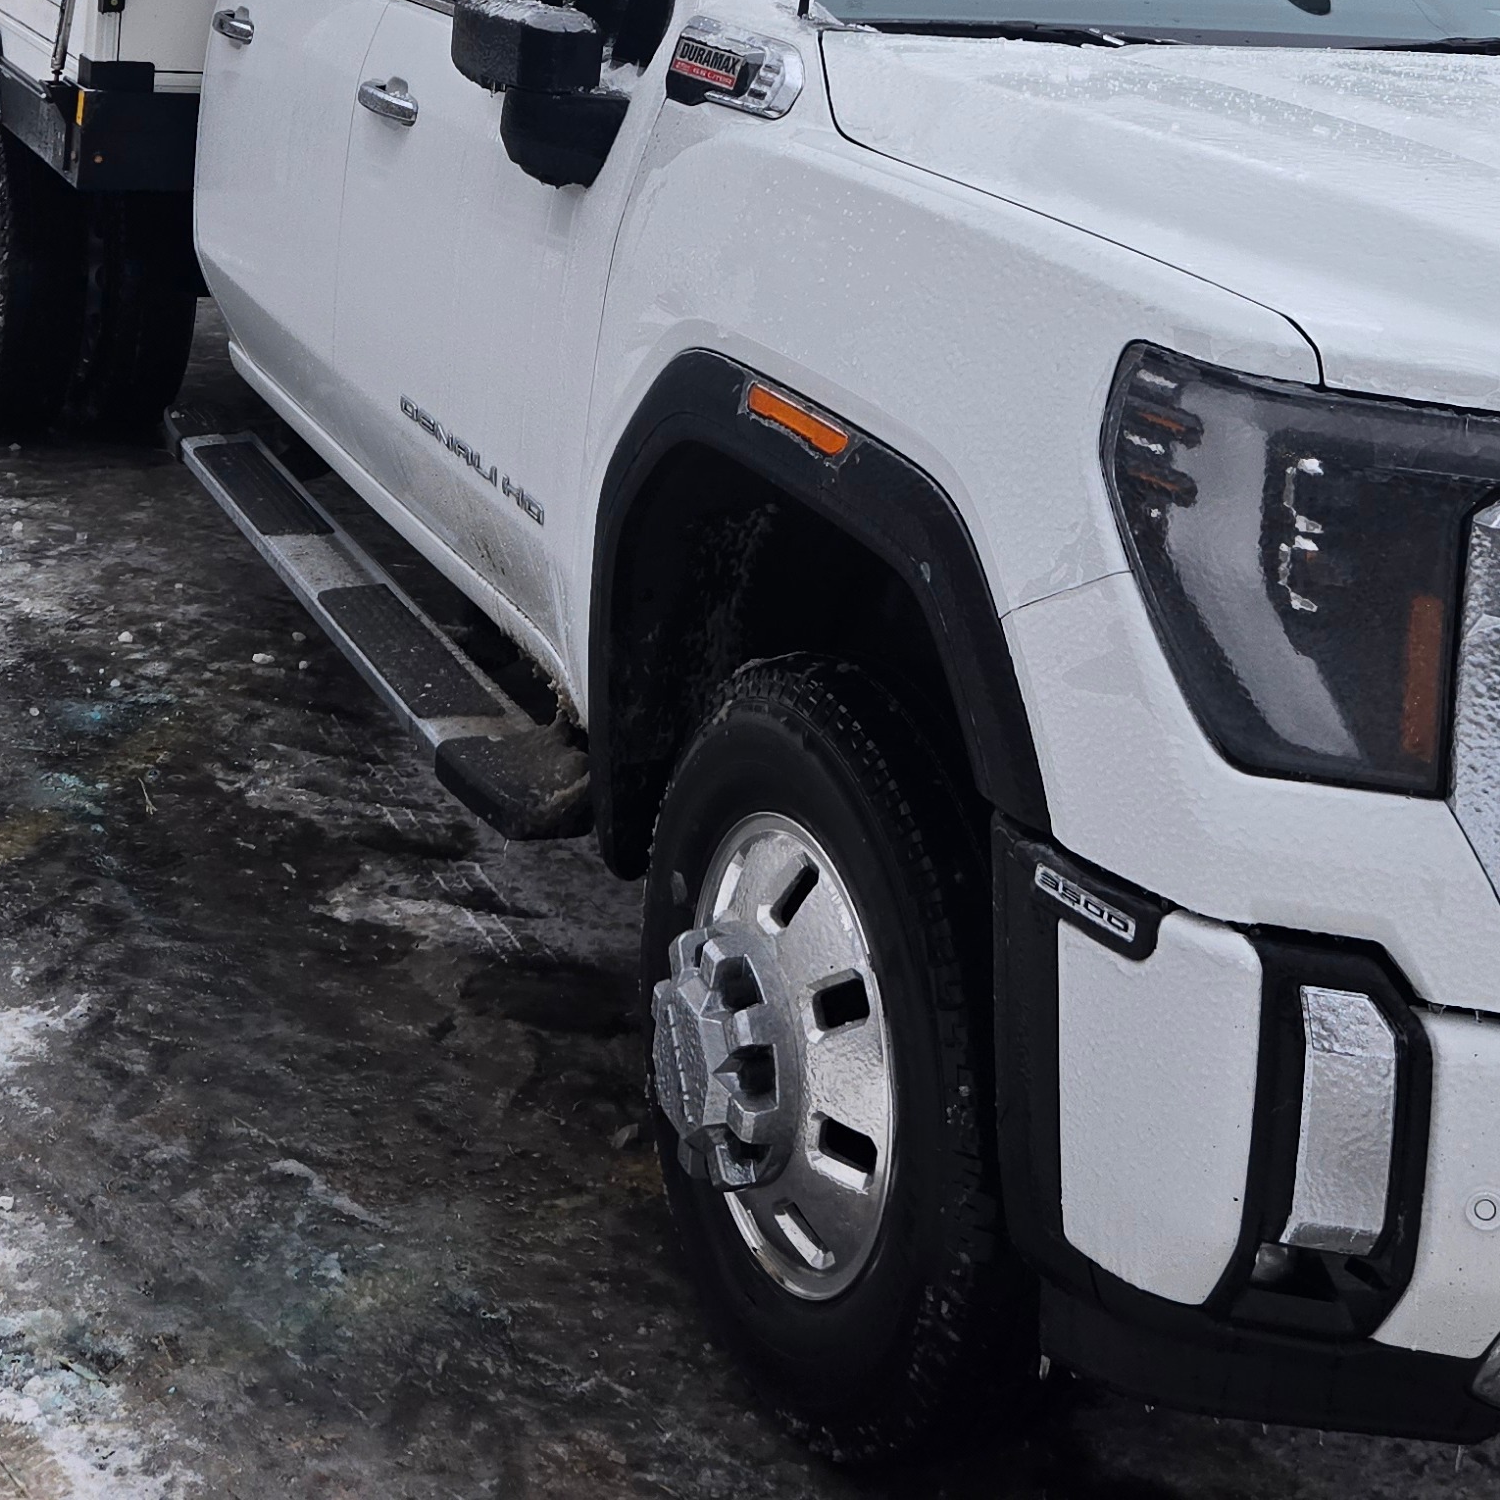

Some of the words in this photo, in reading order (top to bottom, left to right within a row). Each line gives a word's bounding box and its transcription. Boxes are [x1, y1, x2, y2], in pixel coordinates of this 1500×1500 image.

[679, 42, 742, 75] DURAMAX
[399, 392, 498, 488] DENALI
[501, 474, 546, 526] HD
[1039, 871, 1130, 933] 3500
